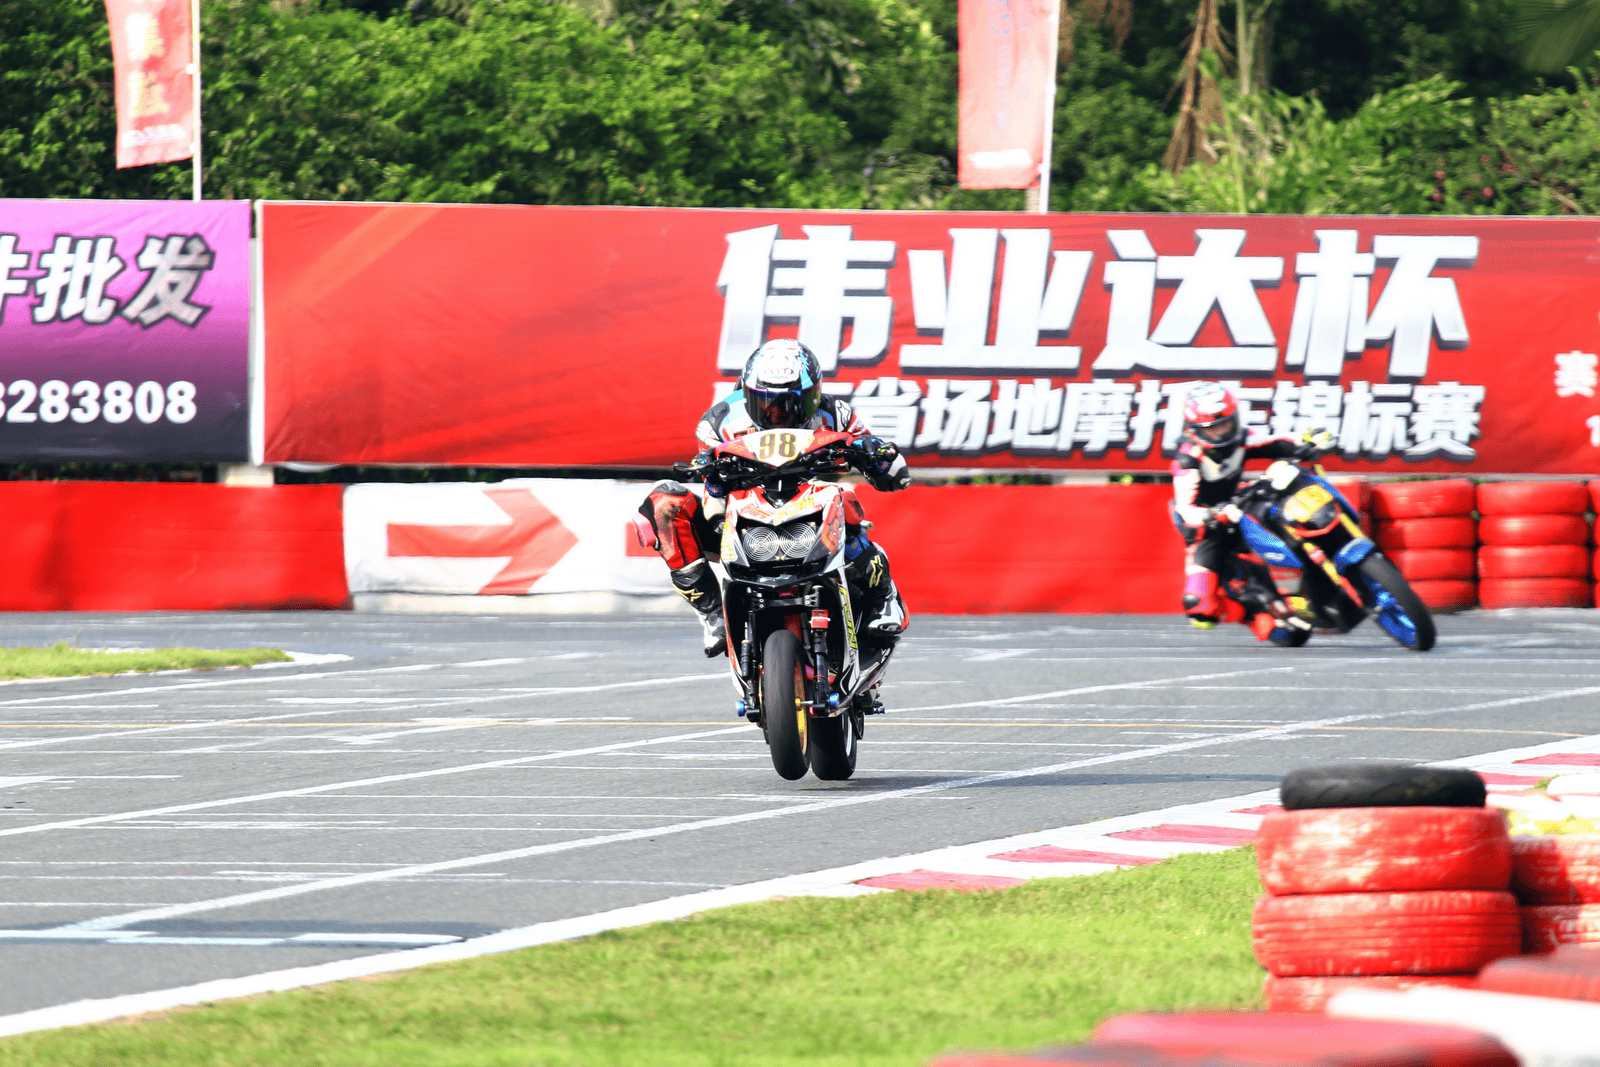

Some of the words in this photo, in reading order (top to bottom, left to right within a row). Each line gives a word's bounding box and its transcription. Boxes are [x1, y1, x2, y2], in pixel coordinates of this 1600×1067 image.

[717, 224, 1479, 382] 伟业达杯
[0, 380, 197, 423] 283808
[713, 377, 1485, 461] 省场地摩托锦标赛
[759, 432, 797, 460] 98
